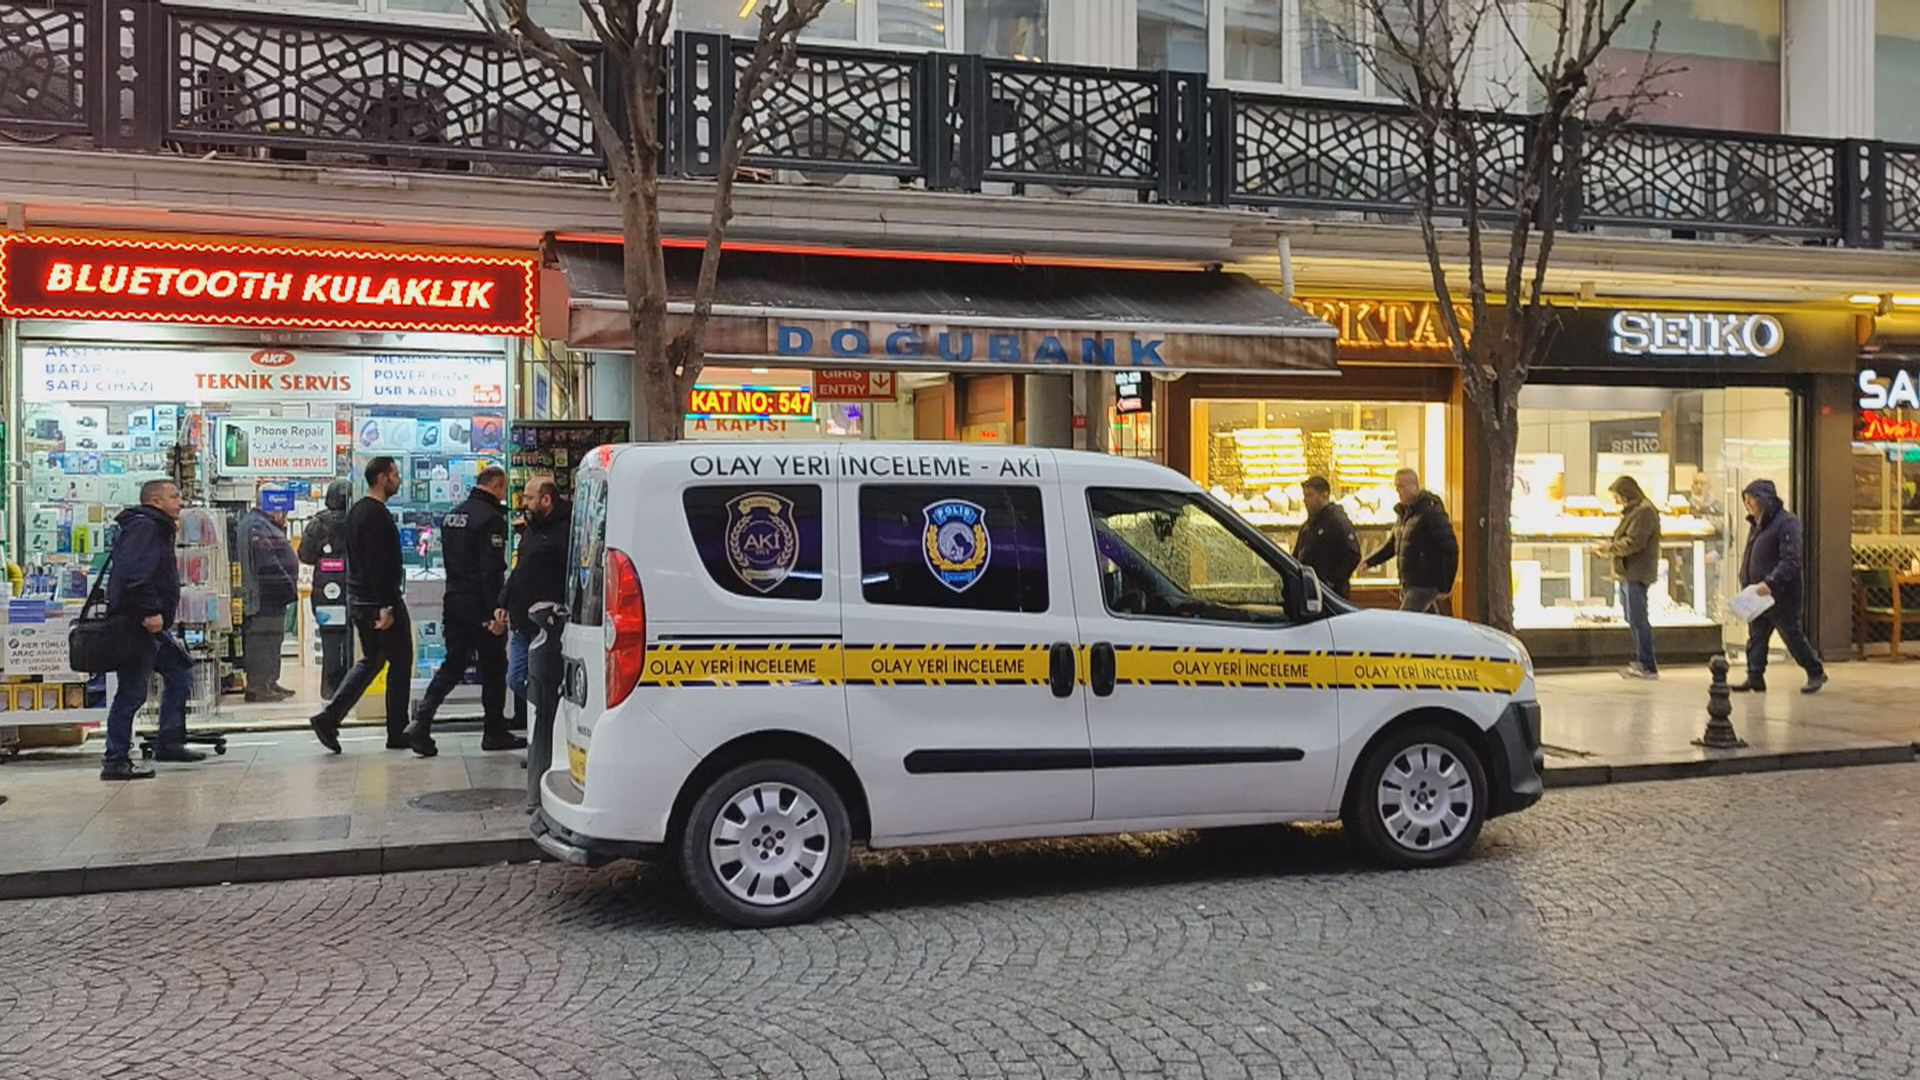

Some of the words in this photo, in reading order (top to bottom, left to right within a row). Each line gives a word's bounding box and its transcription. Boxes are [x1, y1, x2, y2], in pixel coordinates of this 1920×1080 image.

[46, 263, 293, 300] BLUETOOTH
[301, 273, 494, 309] KULAKLIK
[1612, 310, 1784, 357] SEIKO
[776, 322, 1166, 368] DOĞUBANK
[259, 354, 286, 364] AKF
[195, 369, 273, 390] TEKNİK
[280, 371, 351, 391] SERVİS
[374, 369, 425, 381] POWER
[374, 386, 401, 396] USB
[819, 384, 866, 395] ENTRY
[1859, 369, 1920, 409] SA
[691, 391, 732, 412] KAT
[736, 391, 773, 413] NO:
[778, 391, 812, 413] 547
[254, 426, 287, 436] Phone
[290, 426, 325, 438] Repair
[1610, 438, 1660, 453] SEIKO
[690, 455, 762, 476] OLAY
[773, 451, 830, 476] YERİ
[840, 452, 971, 477] İNCELEME
[999, 454, 1041, 478] AKİ
[650, 660, 695, 675] OLAY
[700, 656, 733, 674] YERİ
[739, 656, 816, 674] İNCELEME
[871, 659, 912, 673] OLAY
[917, 655, 948, 673] YERİ
[953, 655, 1024, 674] İNCELEME
[1173, 660, 1210, 675] OLAY
[1214, 659, 1241, 676] YERİ
[1246, 659, 1308, 678] İNCELEME
[1354, 665, 1389, 679] OLAY
[1394, 664, 1419, 679] YERİ
[1423, 664, 1479, 682] İNCELEME
